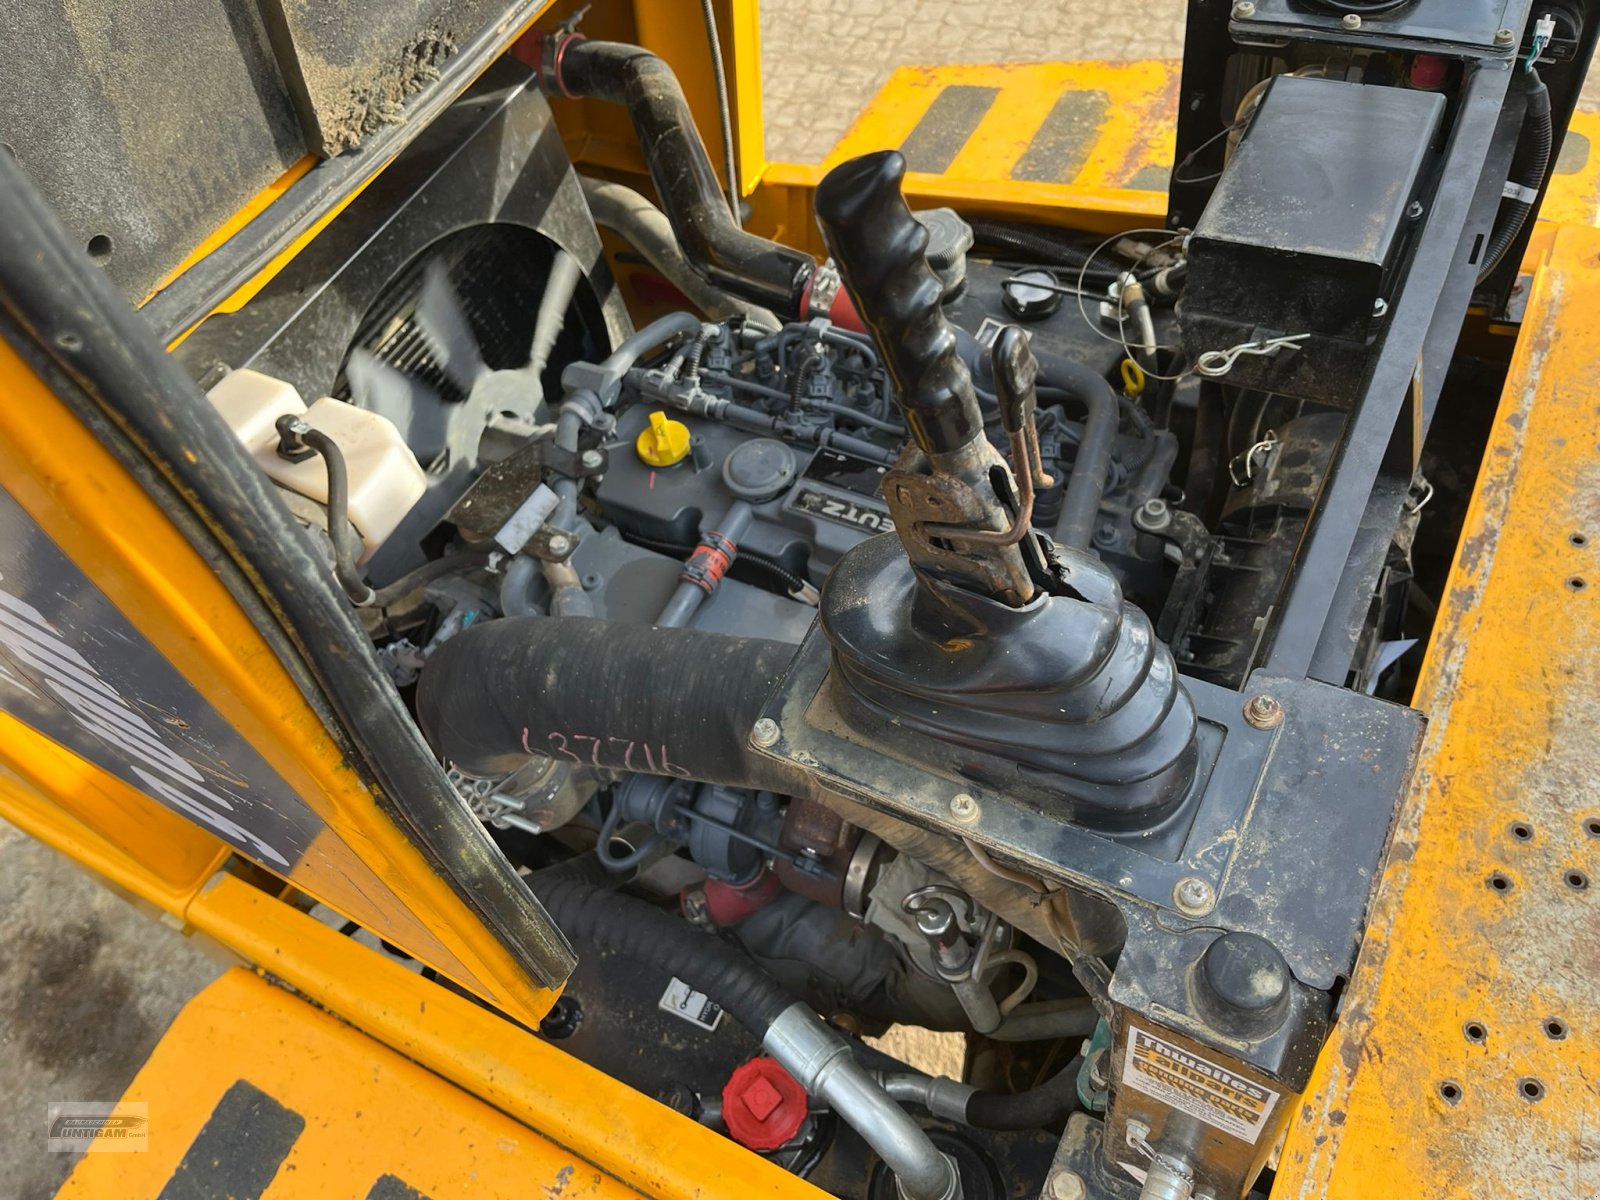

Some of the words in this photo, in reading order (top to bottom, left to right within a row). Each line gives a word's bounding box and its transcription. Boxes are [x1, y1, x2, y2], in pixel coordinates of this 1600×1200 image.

[821, 500, 896, 531] EUTZ
[1140, 1035, 1263, 1099] Thwaites
[1155, 1056, 1259, 1108] allparts
[1209, 1092, 1254, 1119] parts
